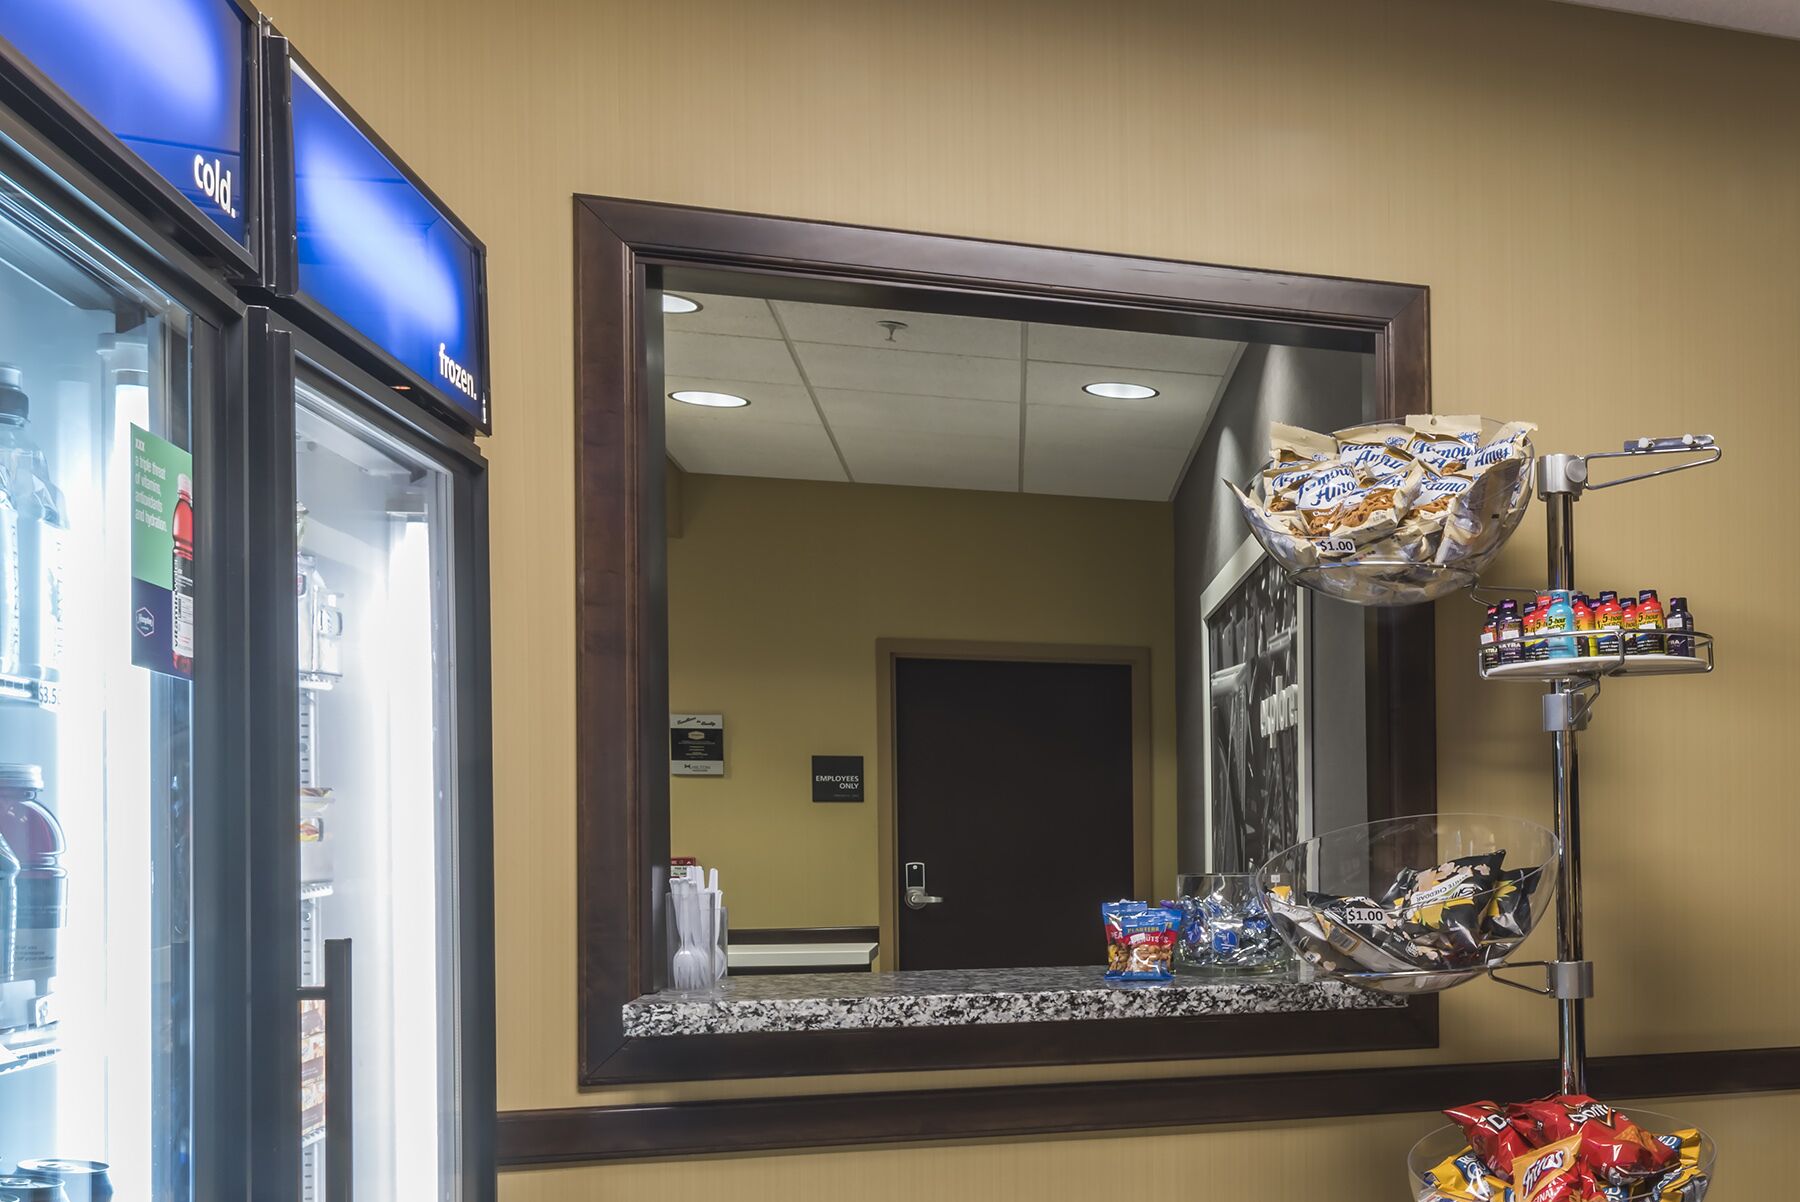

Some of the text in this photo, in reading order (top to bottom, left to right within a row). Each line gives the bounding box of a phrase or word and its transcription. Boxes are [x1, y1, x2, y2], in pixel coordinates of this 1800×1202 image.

[194, 154, 236, 219] cold.
[439, 342, 477, 401] frozen.
[1320, 540, 1353, 552] $1.00
[1548, 616, 1566, 626] 5-hour
[839, 782, 859, 790] ONLY
[1348, 910, 1383, 922] $1.00
[1522, 1150, 1564, 1200] Fritos
